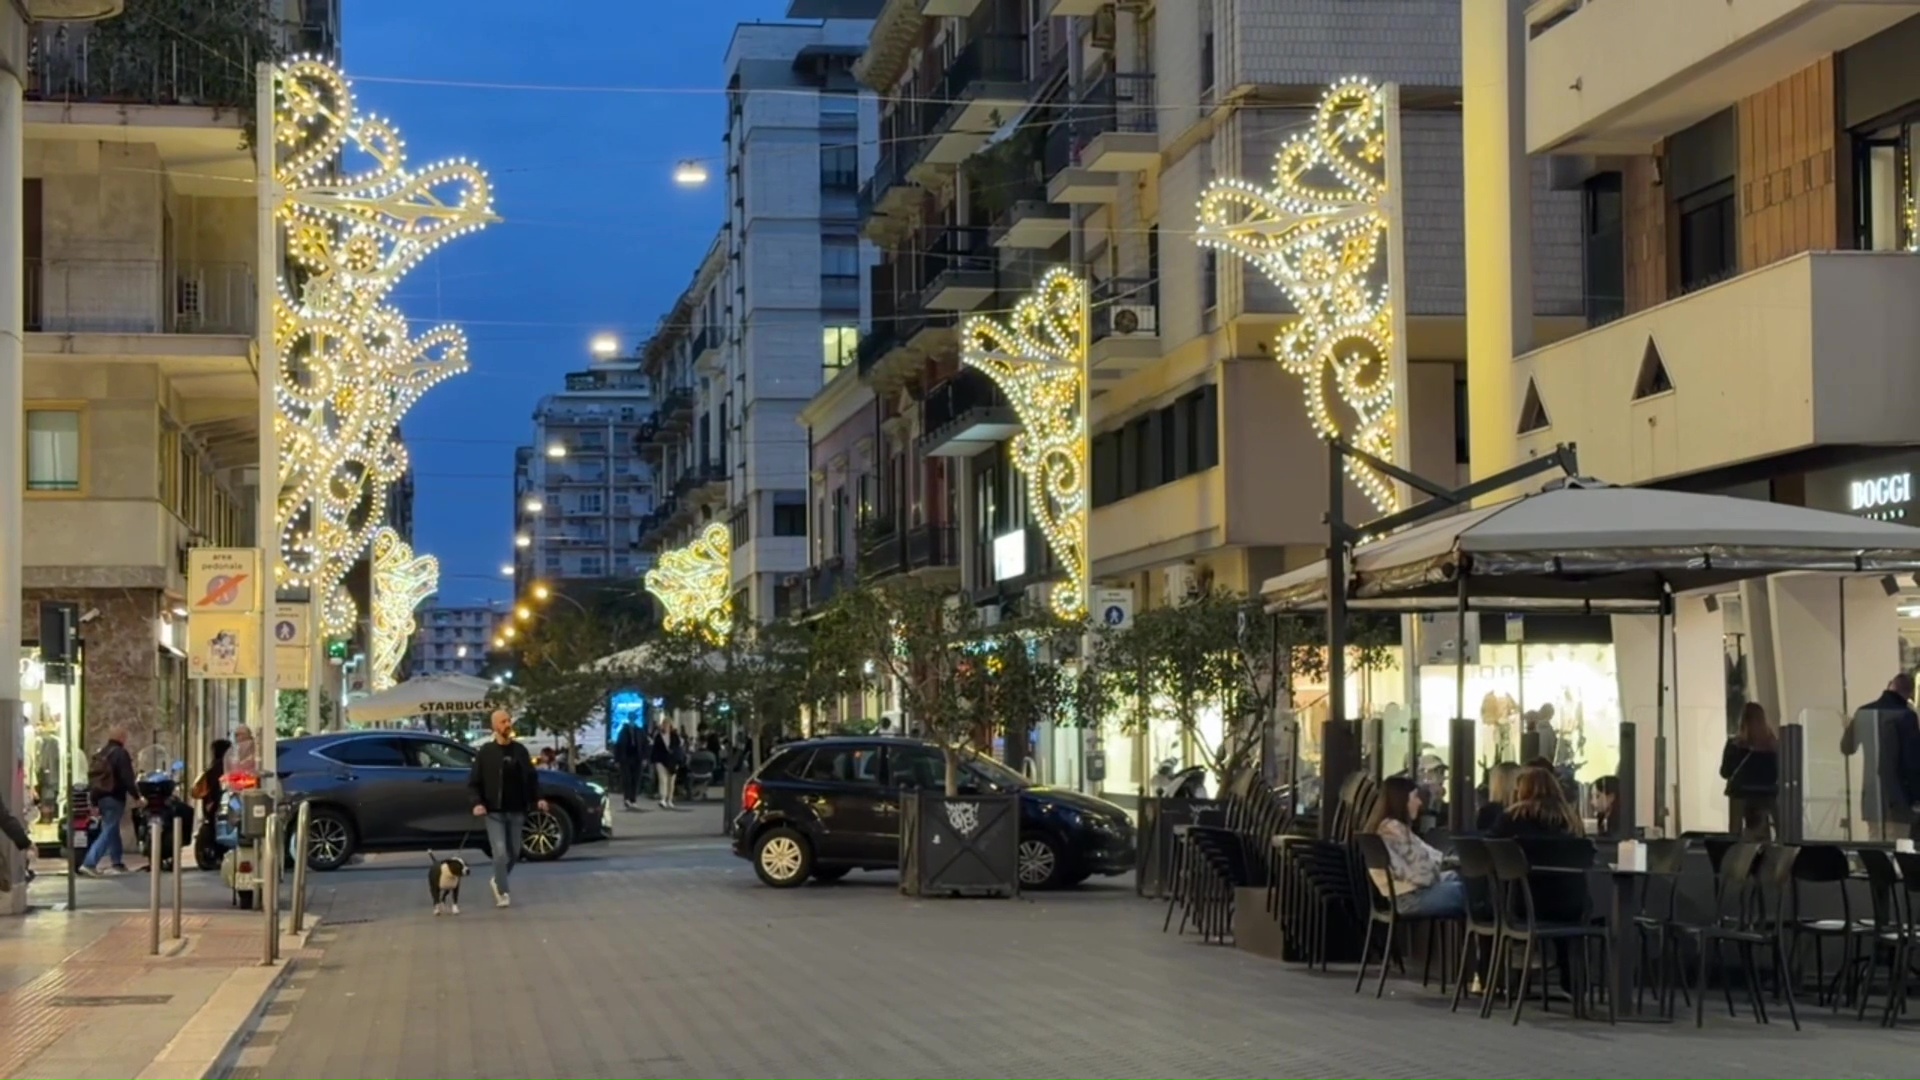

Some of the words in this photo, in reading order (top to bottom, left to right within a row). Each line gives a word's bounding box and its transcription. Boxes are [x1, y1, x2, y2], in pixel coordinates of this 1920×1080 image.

[1851, 472, 1911, 510] BOGGI
[212, 553, 232, 561] area
[419, 701, 500, 712] STARBUCKS
